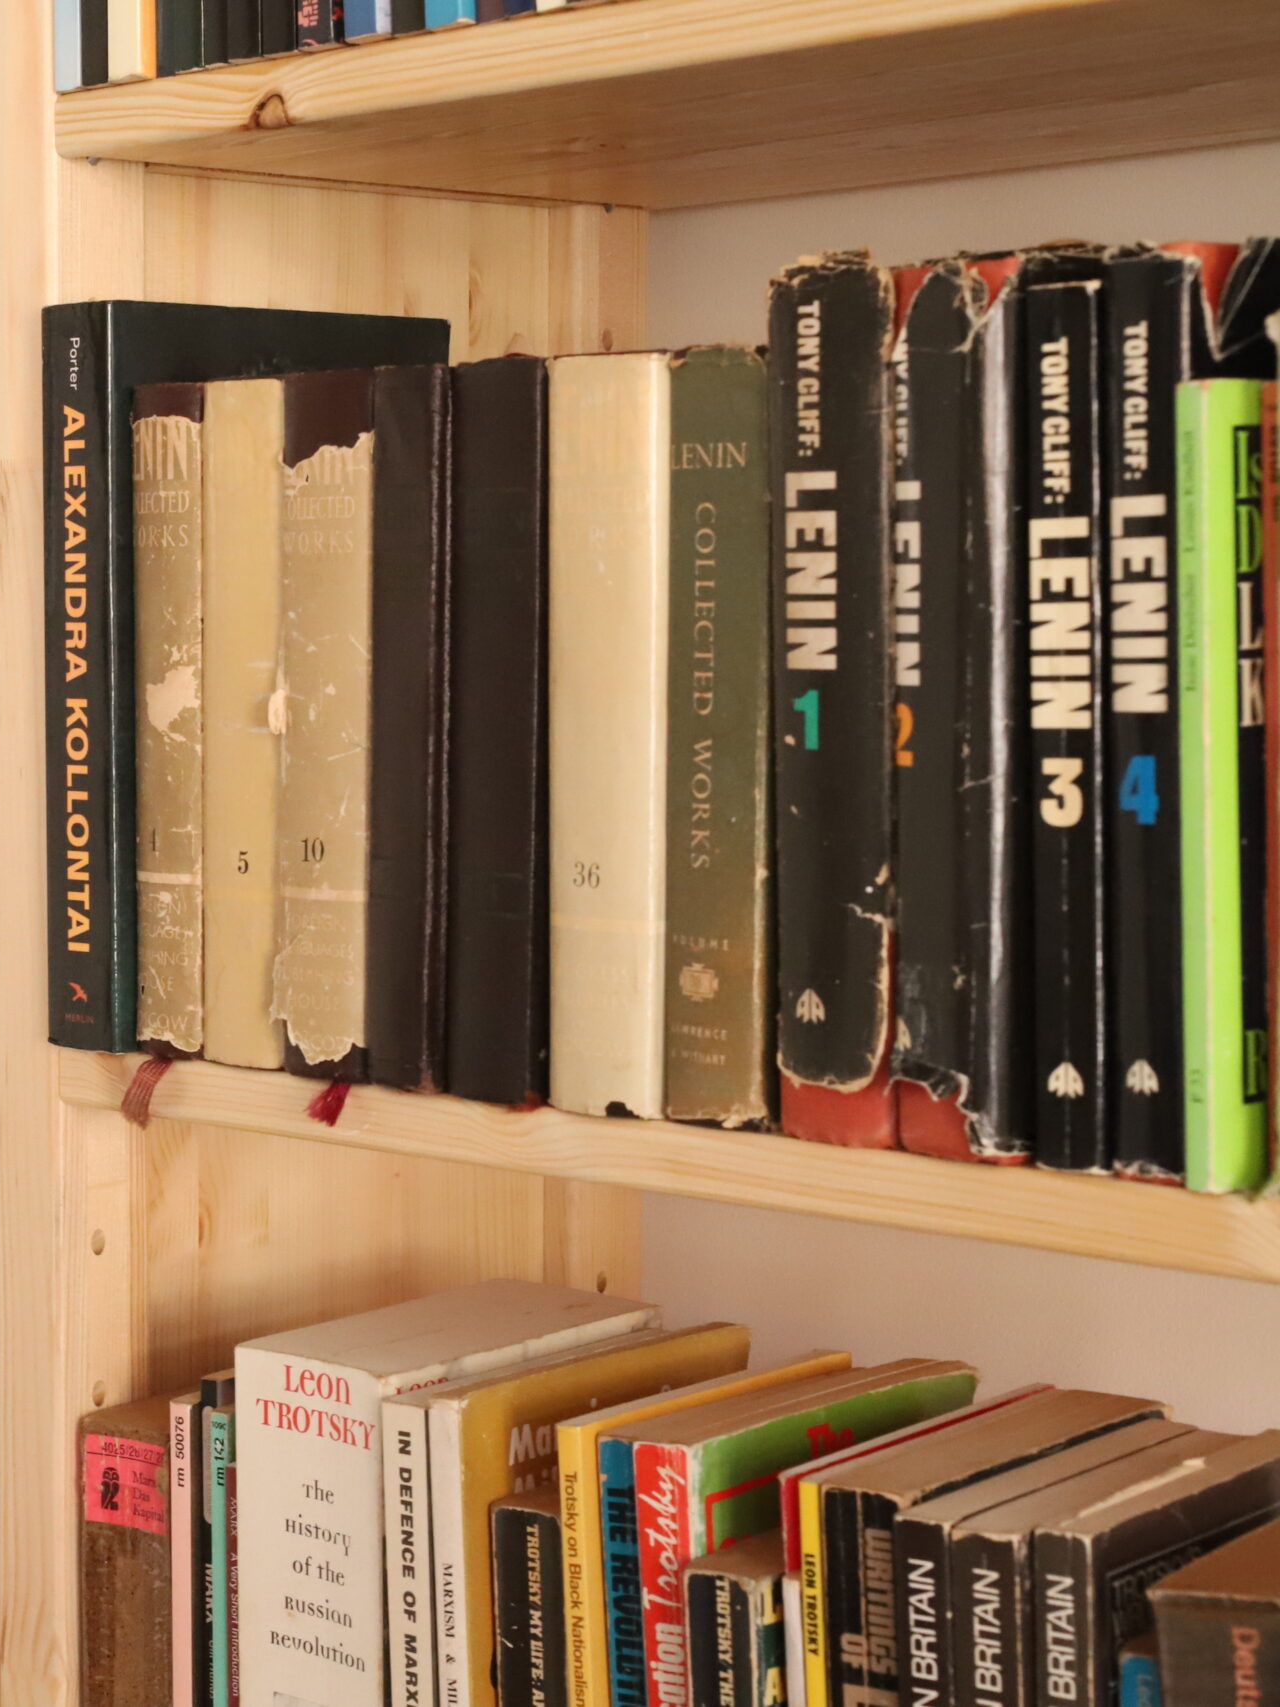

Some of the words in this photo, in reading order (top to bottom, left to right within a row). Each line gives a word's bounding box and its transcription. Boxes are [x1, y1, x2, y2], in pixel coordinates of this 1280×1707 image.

[68, 337, 81, 390] Porter
[797, 300, 820, 374] TONY
[1123, 320, 1148, 391] TONY
[1040, 337, 1070, 413] TONY
[797, 377, 820, 458] CLIFF:
[1124, 393, 1148, 481] CLIFF:
[1042, 415, 1071, 505] CLIFF:
[62, 405, 87, 681] ALEXANDRA
[784, 471, 838, 670] LENIN
[692, 501, 717, 717] COLLECTED
[1029, 516, 1092, 730] LENIN
[1109, 494, 1168, 713] LENIN
[793, 689, 820, 750] 1
[690, 735, 713, 870] WORKS
[1040, 757, 1084, 827] 3
[1120, 755, 1160, 825] 4
[65, 698, 91, 952] KOLLONTAI
[299, 838, 326, 863] 10
[237, 851, 250, 876] 5
[572, 863, 601, 890] 36
[283, 1363, 353, 1406] Leon
[175, 1416, 186, 1460] 50076
[256, 1397, 377, 1451] TROTSKY
[397, 1430, 412, 1455] IN
[177, 1471, 186, 1488] rm
[215, 1465, 225, 1487] rm
[303, 1479, 336, 1505] The
[564, 1471, 578, 1531] Trotsky
[284, 1513, 352, 1557] History
[398, 1466, 416, 1580] DEFENCE
[567, 1537, 578, 1557] on
[638, 1464, 686, 1611] Trotsky
[229, 1564, 239, 1591] Very
[292, 1556, 313, 1577] of
[317, 1564, 346, 1587] the
[442, 1562, 454, 1639] MARXISM
[569, 1563, 582, 1610] Black
[804, 1552, 816, 1590] LEON
[231, 1594, 239, 1625] Short
[284, 1595, 353, 1629] Russian
[401, 1591, 417, 1624] OF
[805, 1594, 819, 1657] TROTSKY
[864, 1528, 898, 1676] WRITINGS
[907, 1558, 940, 1684] BRITAIN
[972, 1567, 1005, 1697] BRITAIN
[231, 1626, 240, 1697] Introduction
[270, 1630, 366, 1673] Revolution
[445, 1654, 456, 1664] &
[841, 1632, 867, 1673] OF
[1045, 1573, 1080, 1701] BRITAIN
